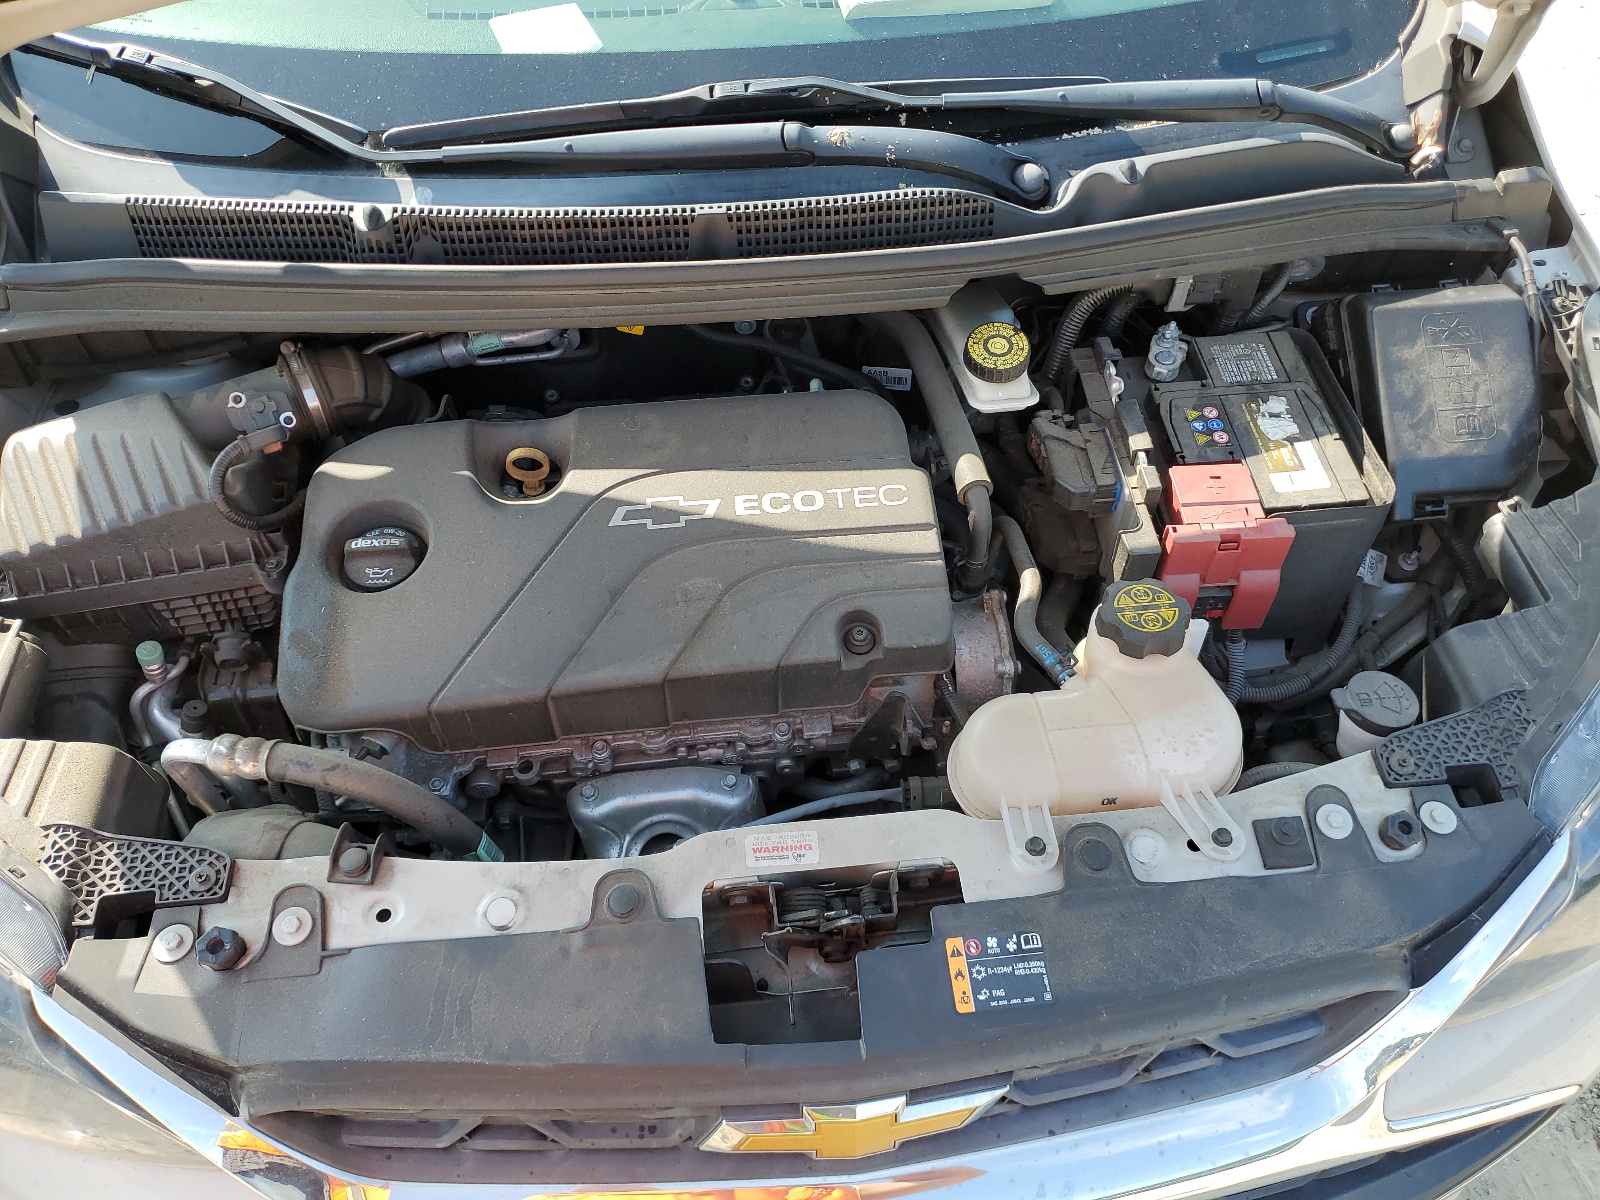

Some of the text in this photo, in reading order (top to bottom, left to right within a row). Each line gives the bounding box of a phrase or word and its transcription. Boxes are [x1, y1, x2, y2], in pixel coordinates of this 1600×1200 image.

[734, 484, 909, 516] ECOTEC
[351, 538, 400, 548] dexos
[1101, 797, 1118, 806] OK
[752, 844, 813, 854] WARNING
[992, 989, 1006, 997] PAG
